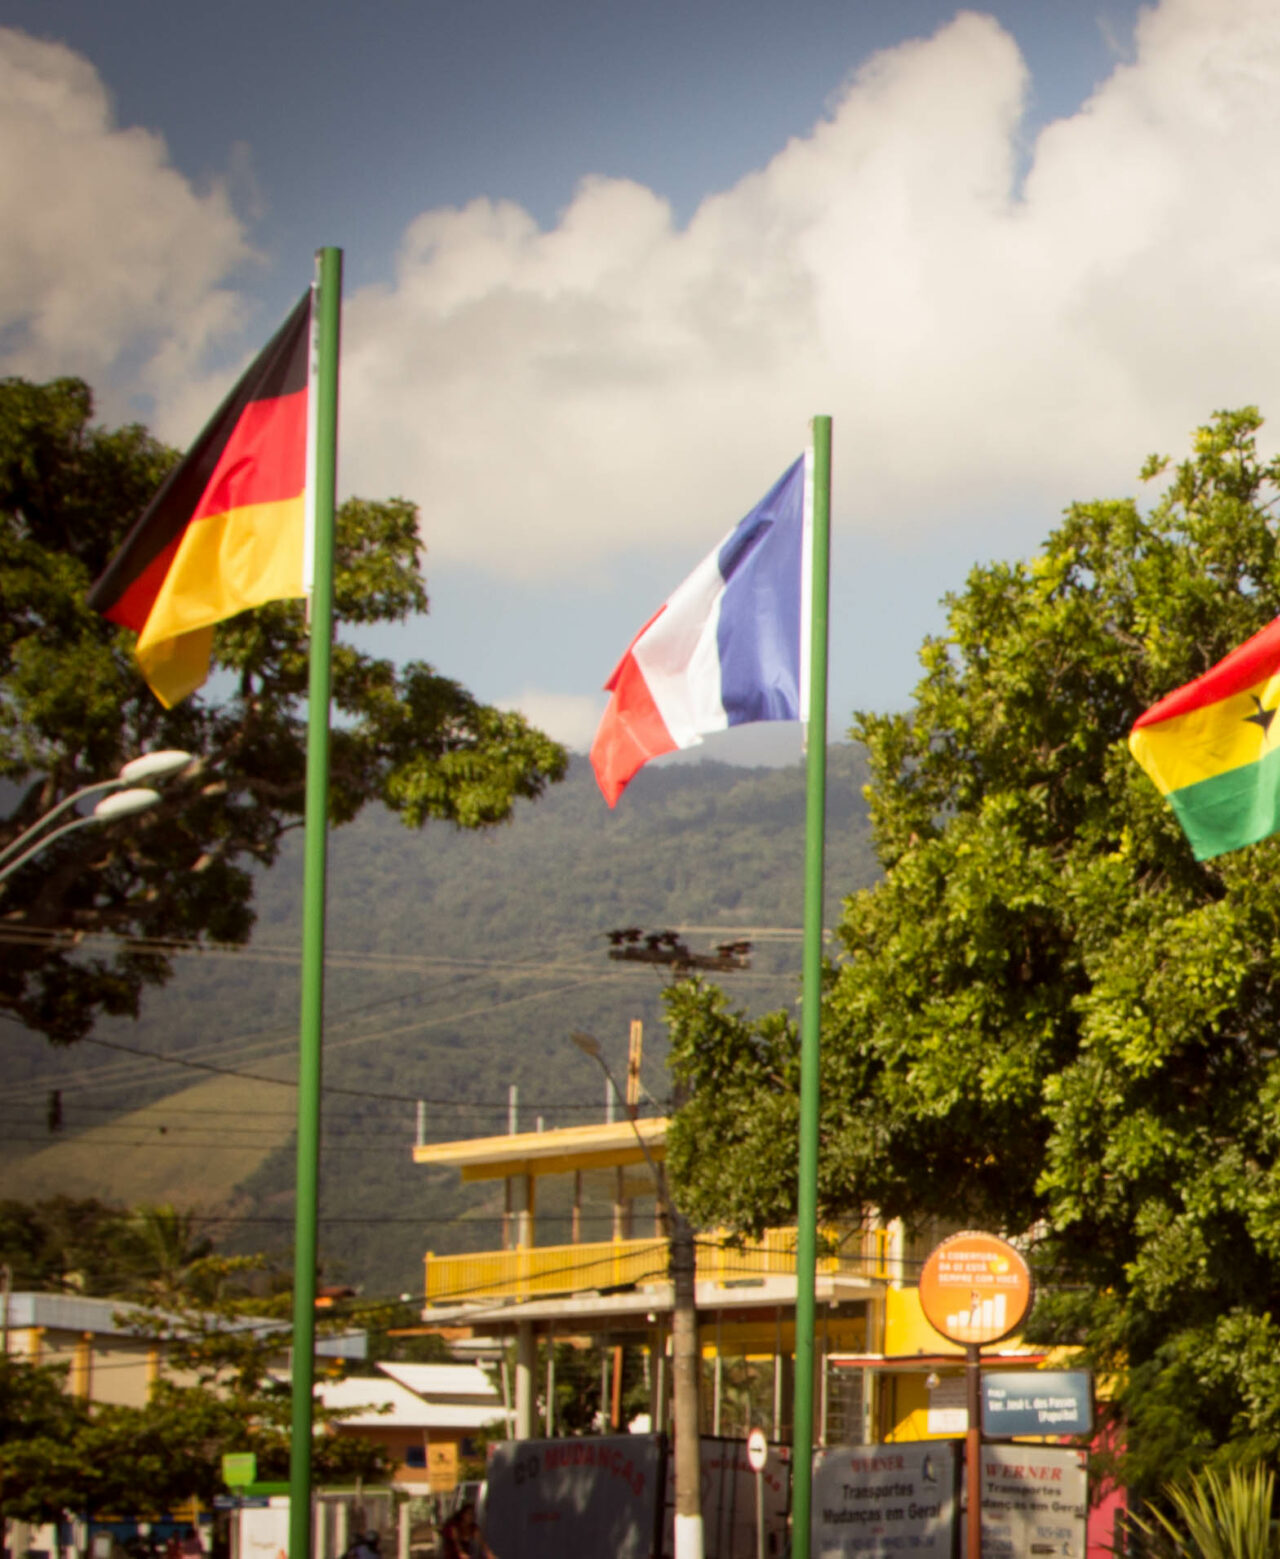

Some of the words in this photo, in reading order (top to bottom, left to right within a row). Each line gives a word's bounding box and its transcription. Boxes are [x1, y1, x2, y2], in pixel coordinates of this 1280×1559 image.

[986, 1463, 1062, 1480] WERNER
[843, 1483, 914, 1502] Transportes
[988, 1482, 1062, 1497] Transportes
[822, 1507, 880, 1525] Mudanças
[885, 1508, 904, 1521] em
[908, 1501, 942, 1520] Geral
